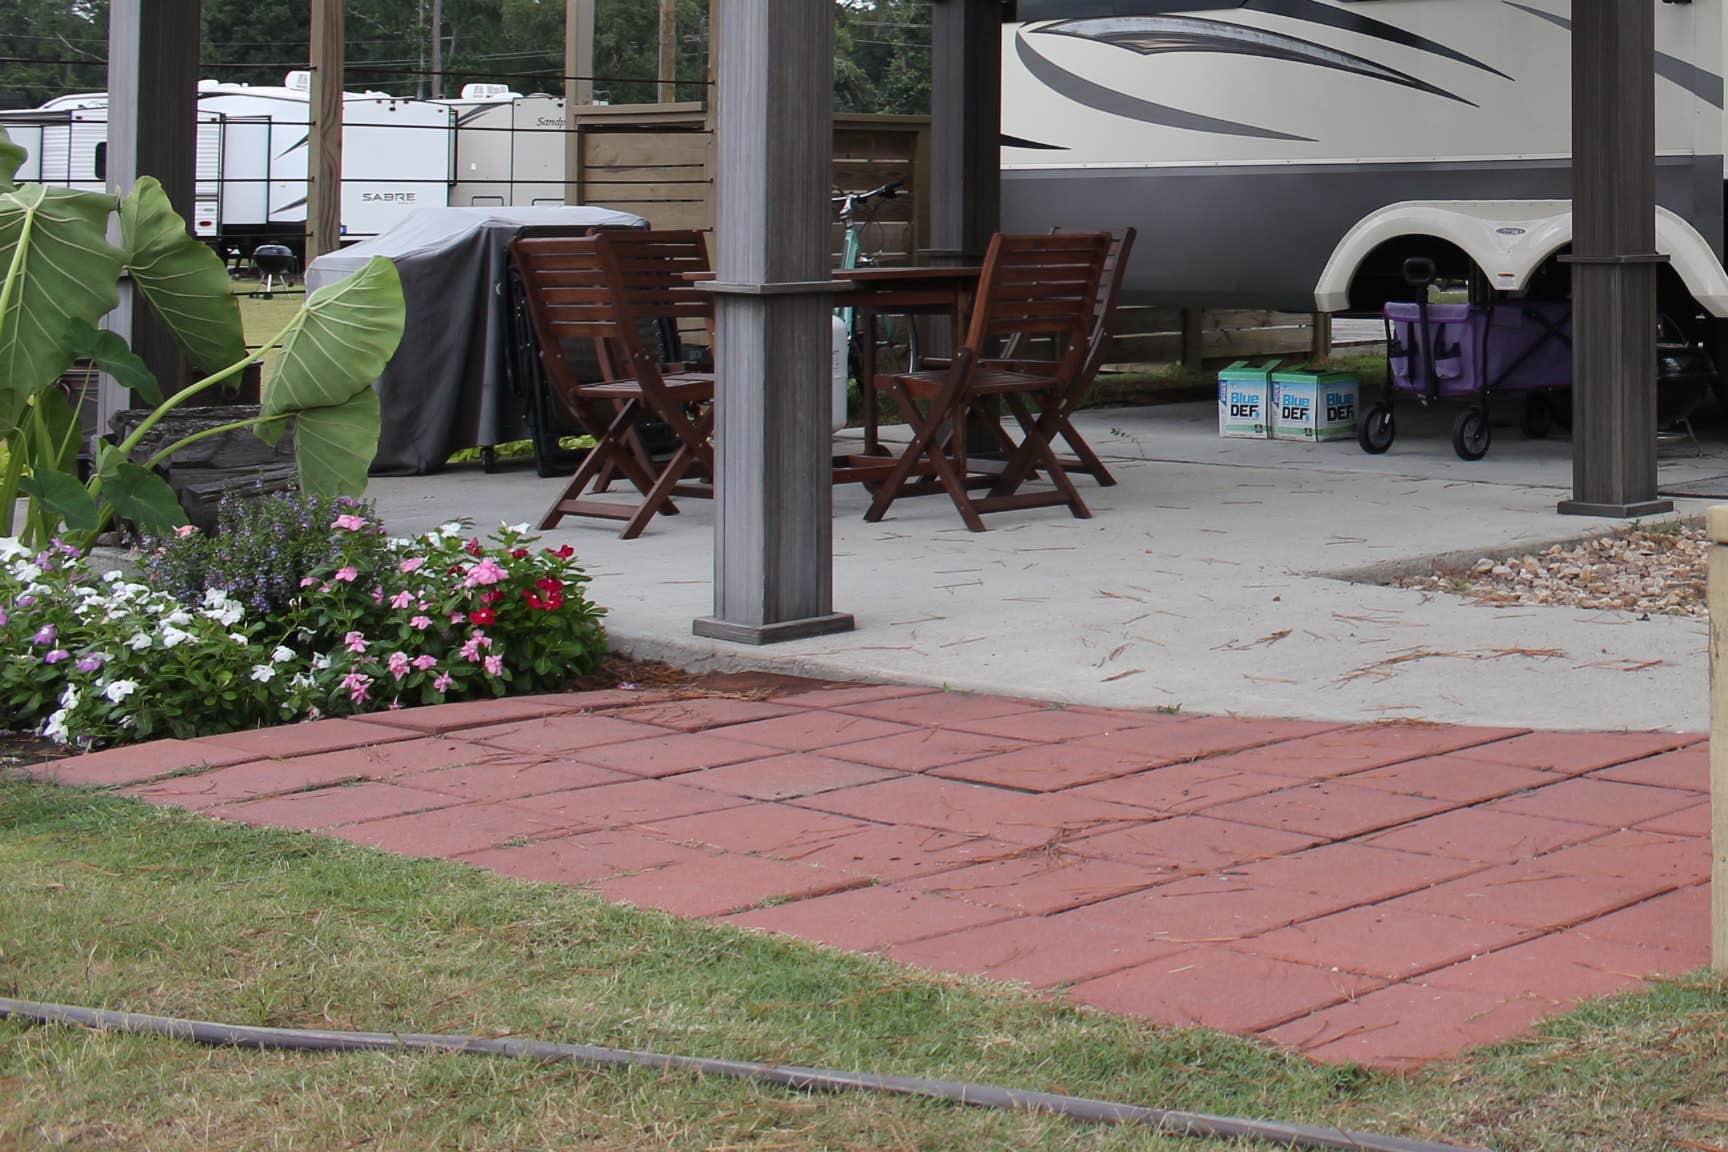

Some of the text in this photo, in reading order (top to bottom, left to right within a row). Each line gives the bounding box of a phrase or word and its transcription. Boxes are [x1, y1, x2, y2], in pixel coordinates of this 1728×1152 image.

[362, 193, 416, 202] SABRE
[1231, 392, 1259, 404] Blue
[1283, 394, 1310, 408] Blue
[1327, 393, 1354, 406] Blue
[1230, 404, 1259, 417] DEF
[1282, 407, 1310, 420] DEF
[1327, 405, 1354, 422] DEF
